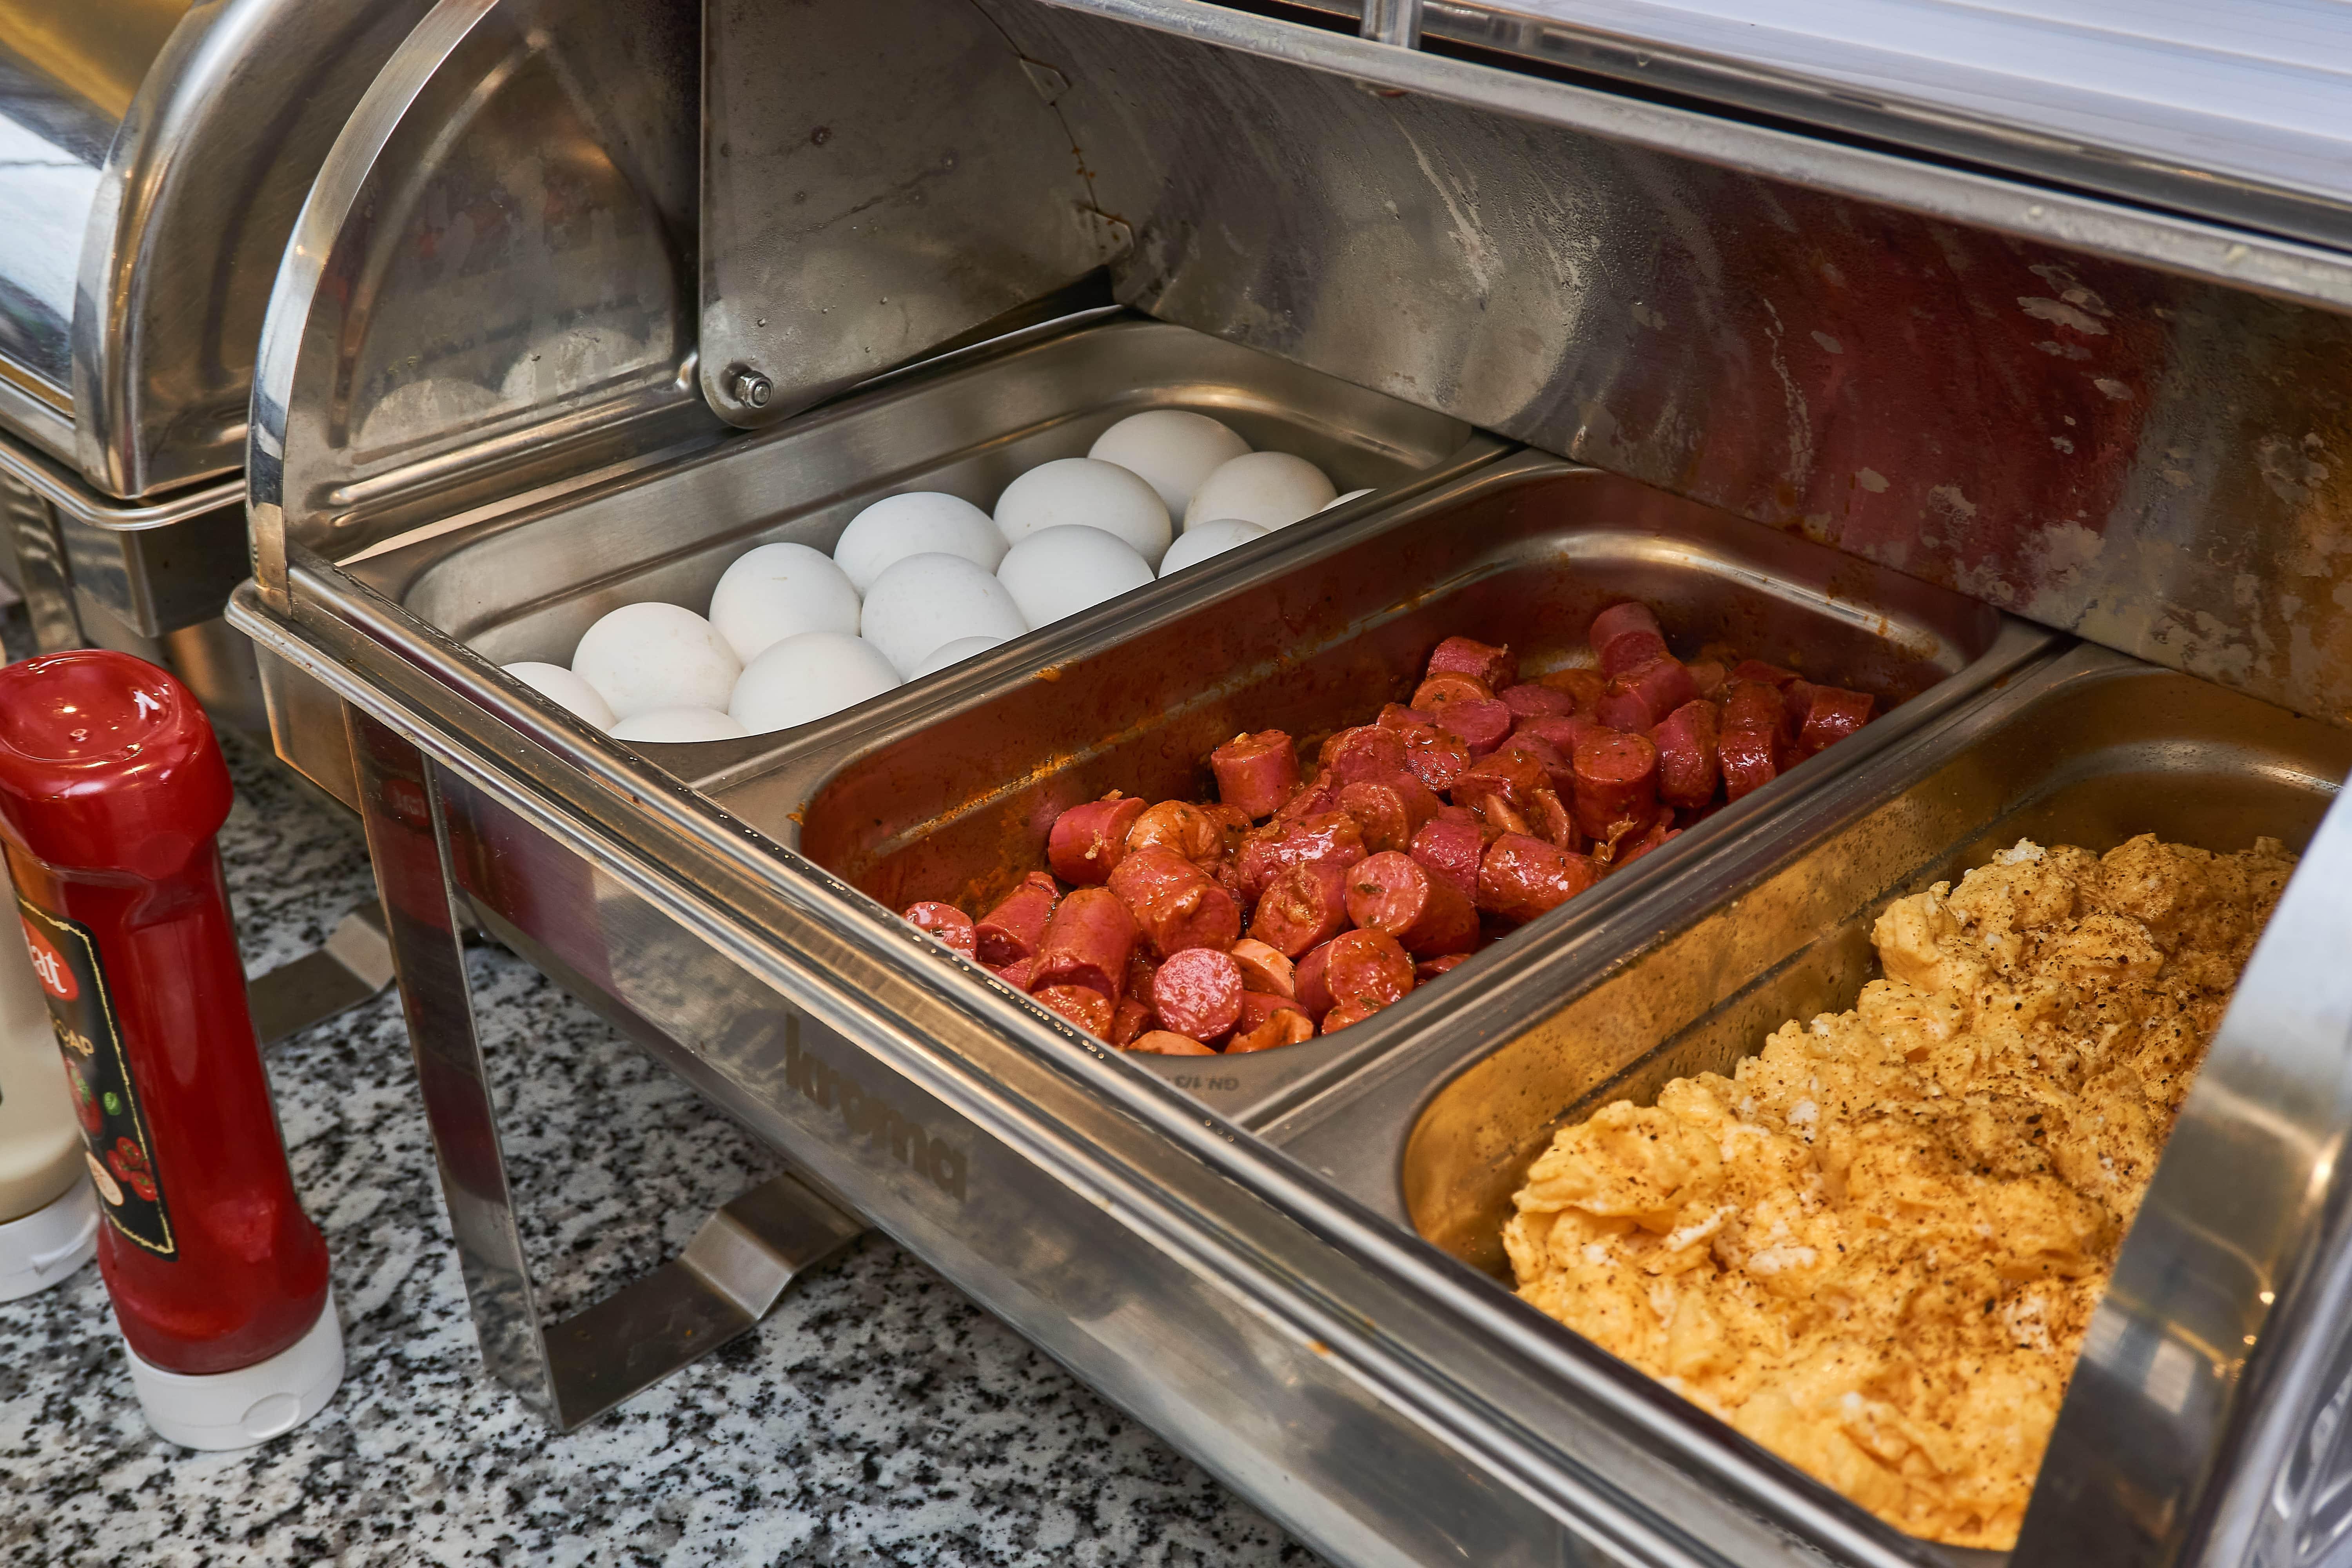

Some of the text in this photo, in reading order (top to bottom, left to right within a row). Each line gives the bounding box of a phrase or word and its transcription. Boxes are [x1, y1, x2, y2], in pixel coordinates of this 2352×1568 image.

[26, 941, 67, 993] at
[786, 1013, 967, 1204] kroma
[1209, 1076, 1240, 1091] GN
